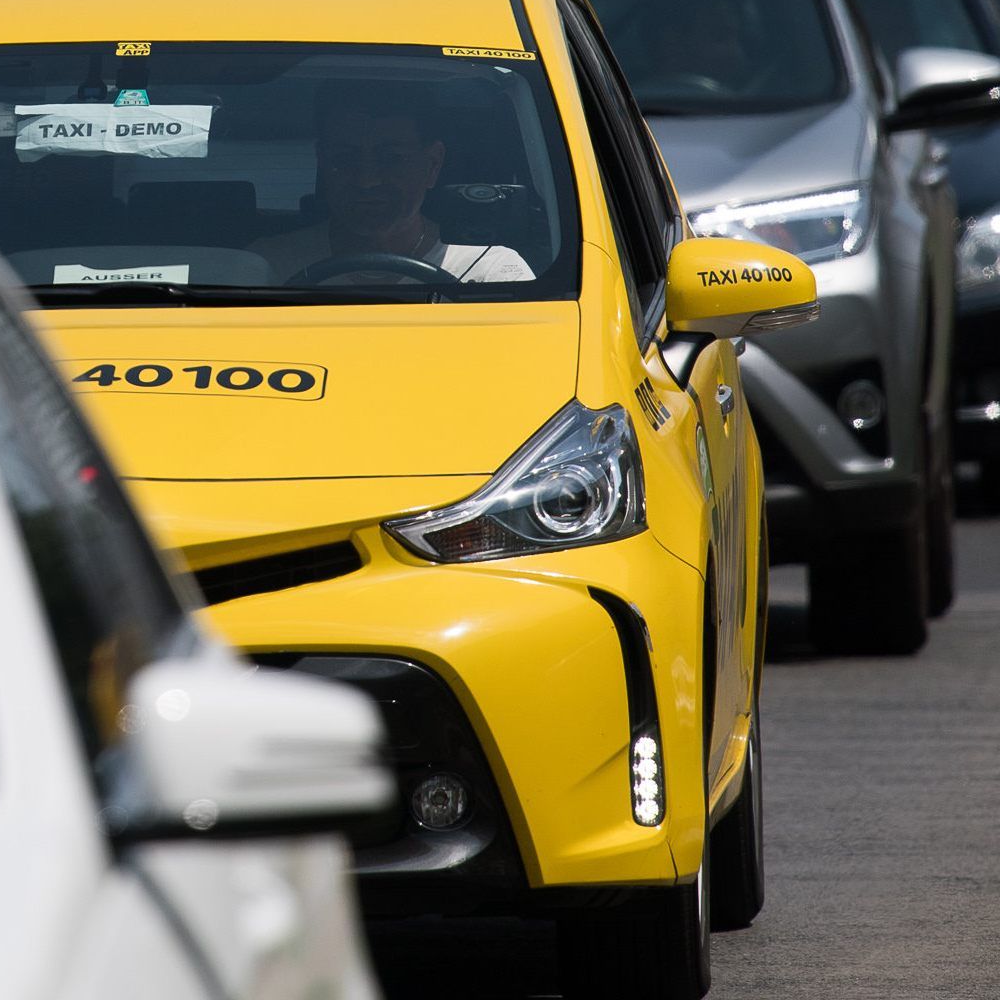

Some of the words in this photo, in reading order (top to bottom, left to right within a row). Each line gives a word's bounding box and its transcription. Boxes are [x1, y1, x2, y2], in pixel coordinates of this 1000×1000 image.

[447, 48, 480, 56] TAXI
[39, 123, 93, 138] TAXI
[115, 122, 182, 137] DEMO
[81, 272, 163, 281] AUSSER
[697, 269, 738, 287] TAXI
